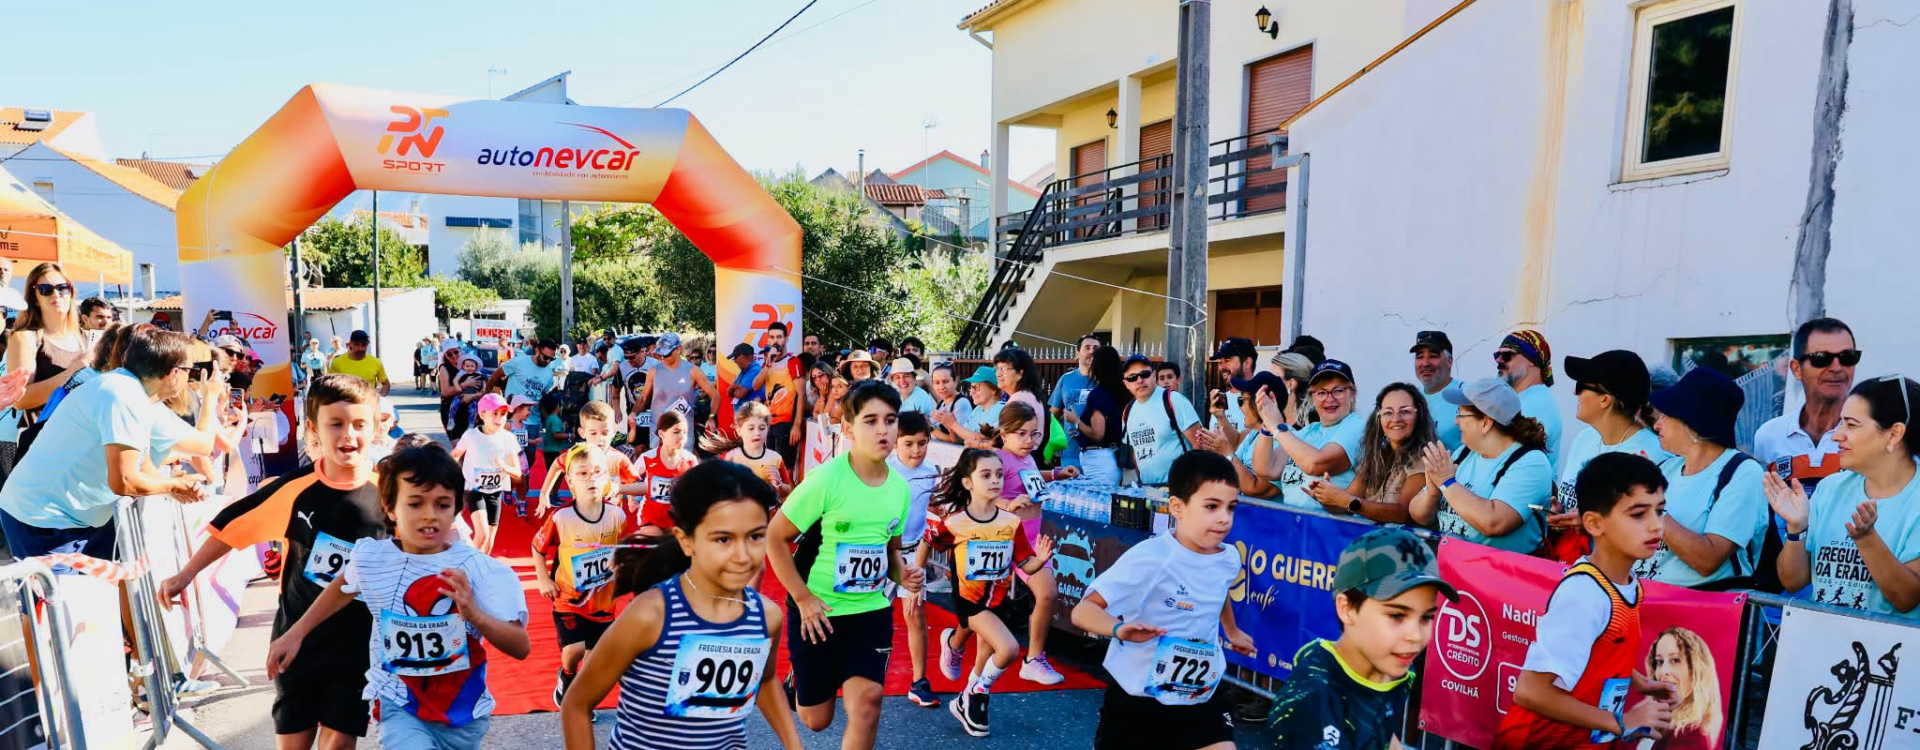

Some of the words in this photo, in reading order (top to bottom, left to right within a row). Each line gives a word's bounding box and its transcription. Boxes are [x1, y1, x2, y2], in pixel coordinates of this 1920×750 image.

[383, 160, 445, 173] SPORT
[478, 146, 641, 171] autonevcar
[481, 475, 500, 486] 720
[849, 557, 881, 579] 709
[981, 551, 1004, 570] 711
[1250, 549, 1267, 575] O
[1815, 561, 1831, 577] DA
[1250, 584, 1279, 613] café
[429, 621, 449, 629] ERADA
[1442, 607, 1481, 648] DS
[396, 630, 445, 659] 913
[698, 643, 732, 654] FREGUESIA
[743, 647, 761, 655] ERADA
[1446, 649, 1480, 668] CRÉDITO
[695, 657, 754, 695] 909
[1170, 654, 1210, 686] 722
[1441, 679, 1479, 699] COVILHÃ
